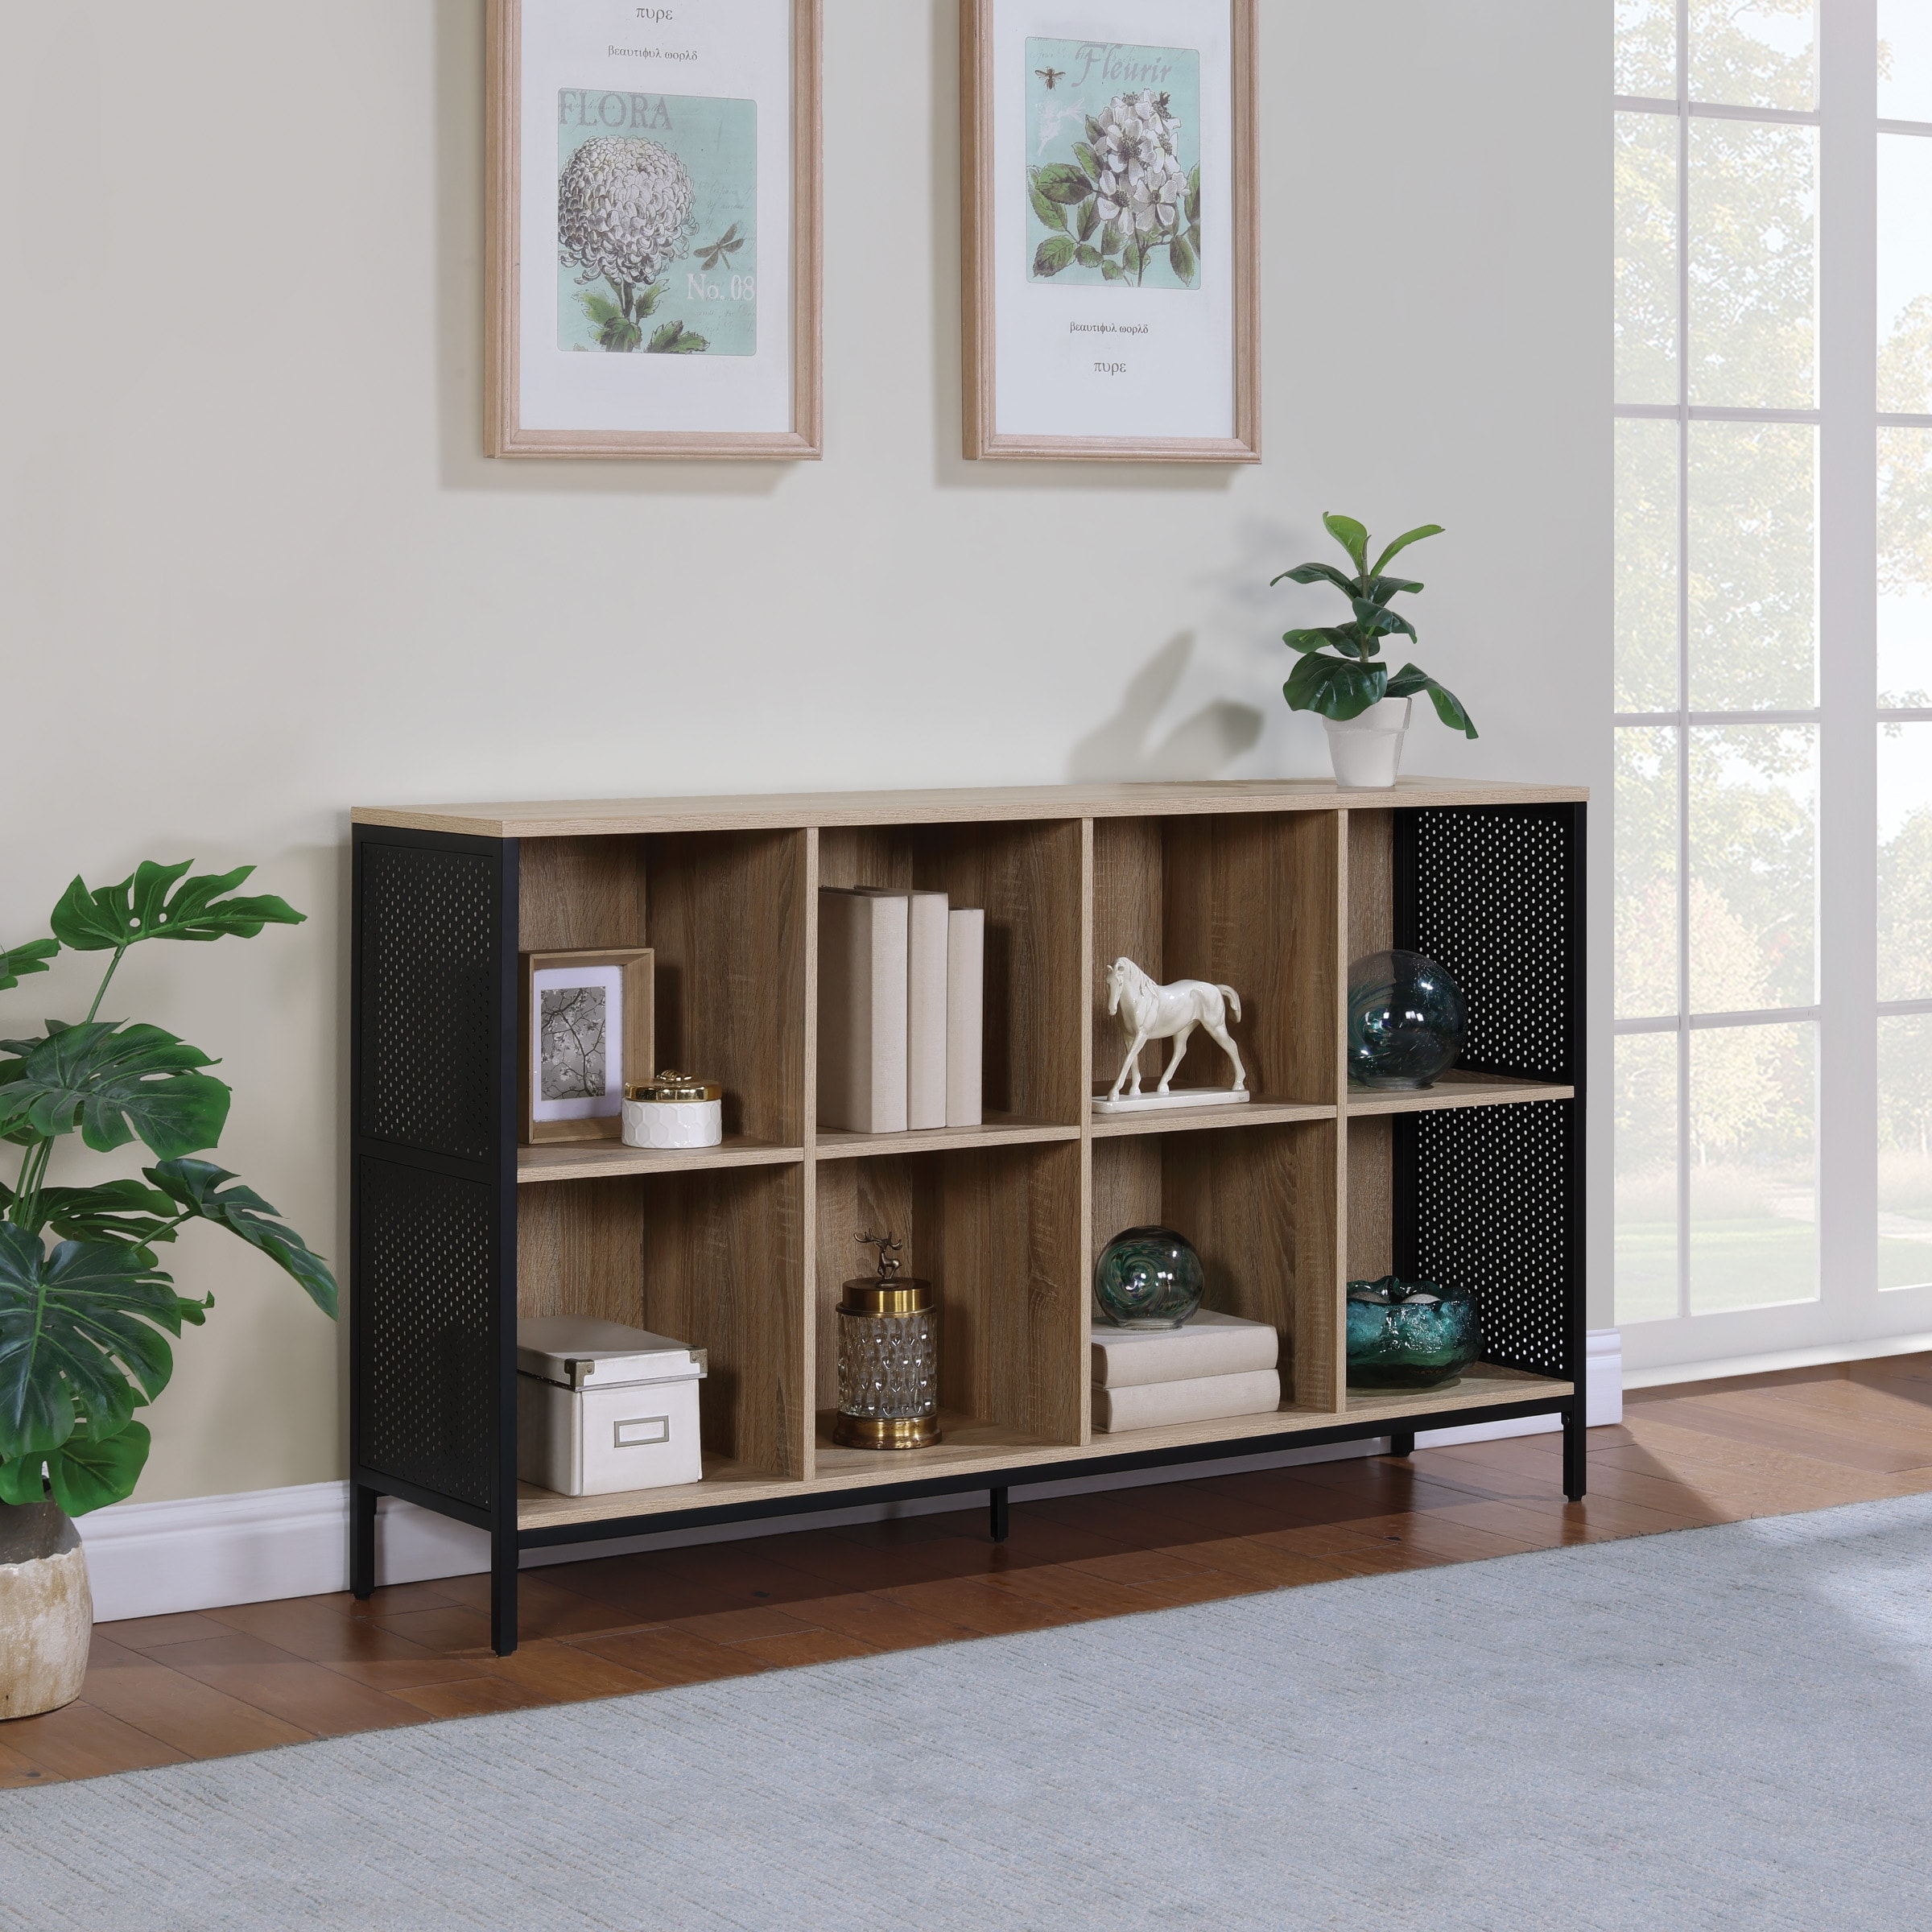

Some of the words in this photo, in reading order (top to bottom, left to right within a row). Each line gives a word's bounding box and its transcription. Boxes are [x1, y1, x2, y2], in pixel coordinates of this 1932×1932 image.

[636, 7, 673, 23] πυρε
[1071, 43, 1173, 88] Fleurir
[559, 90, 673, 130] FLORA
[687, 273, 724, 300] No.
[730, 275, 755, 301] 08
[1093, 361, 1126, 376] πυρε
